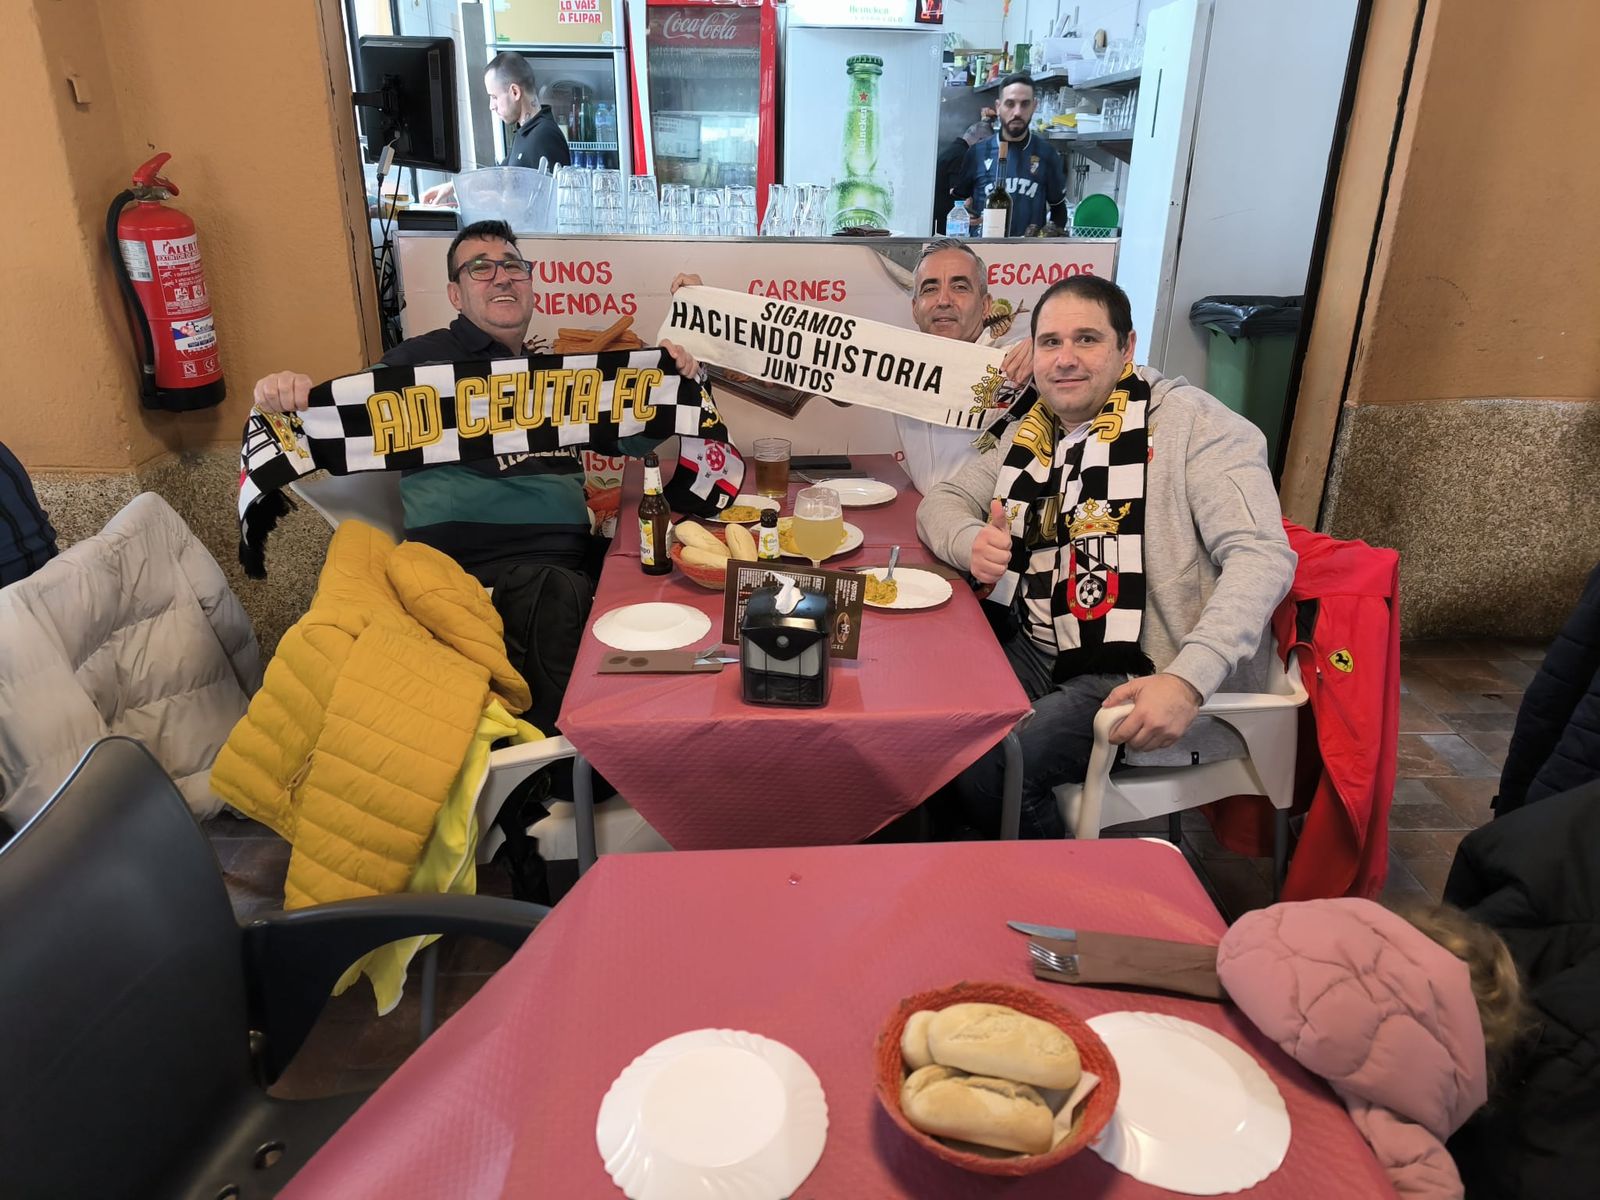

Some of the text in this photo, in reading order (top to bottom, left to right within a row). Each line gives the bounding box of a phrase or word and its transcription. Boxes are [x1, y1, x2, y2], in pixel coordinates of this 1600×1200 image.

[561, 0, 596, 10] LO VAIS
[560, 13, 601, 23] A FLIPAR
[984, 177, 1039, 198] CUTA
[532, 261, 613, 284] UNOS
[748, 279, 847, 302] CARNES
[761, 302, 856, 340] SIGAMOS
[671, 301, 944, 394] HACIENDO HISTORIA
[761, 357, 835, 393] JUNTOS
[366, 367, 663, 456] AD CEUTA FC
